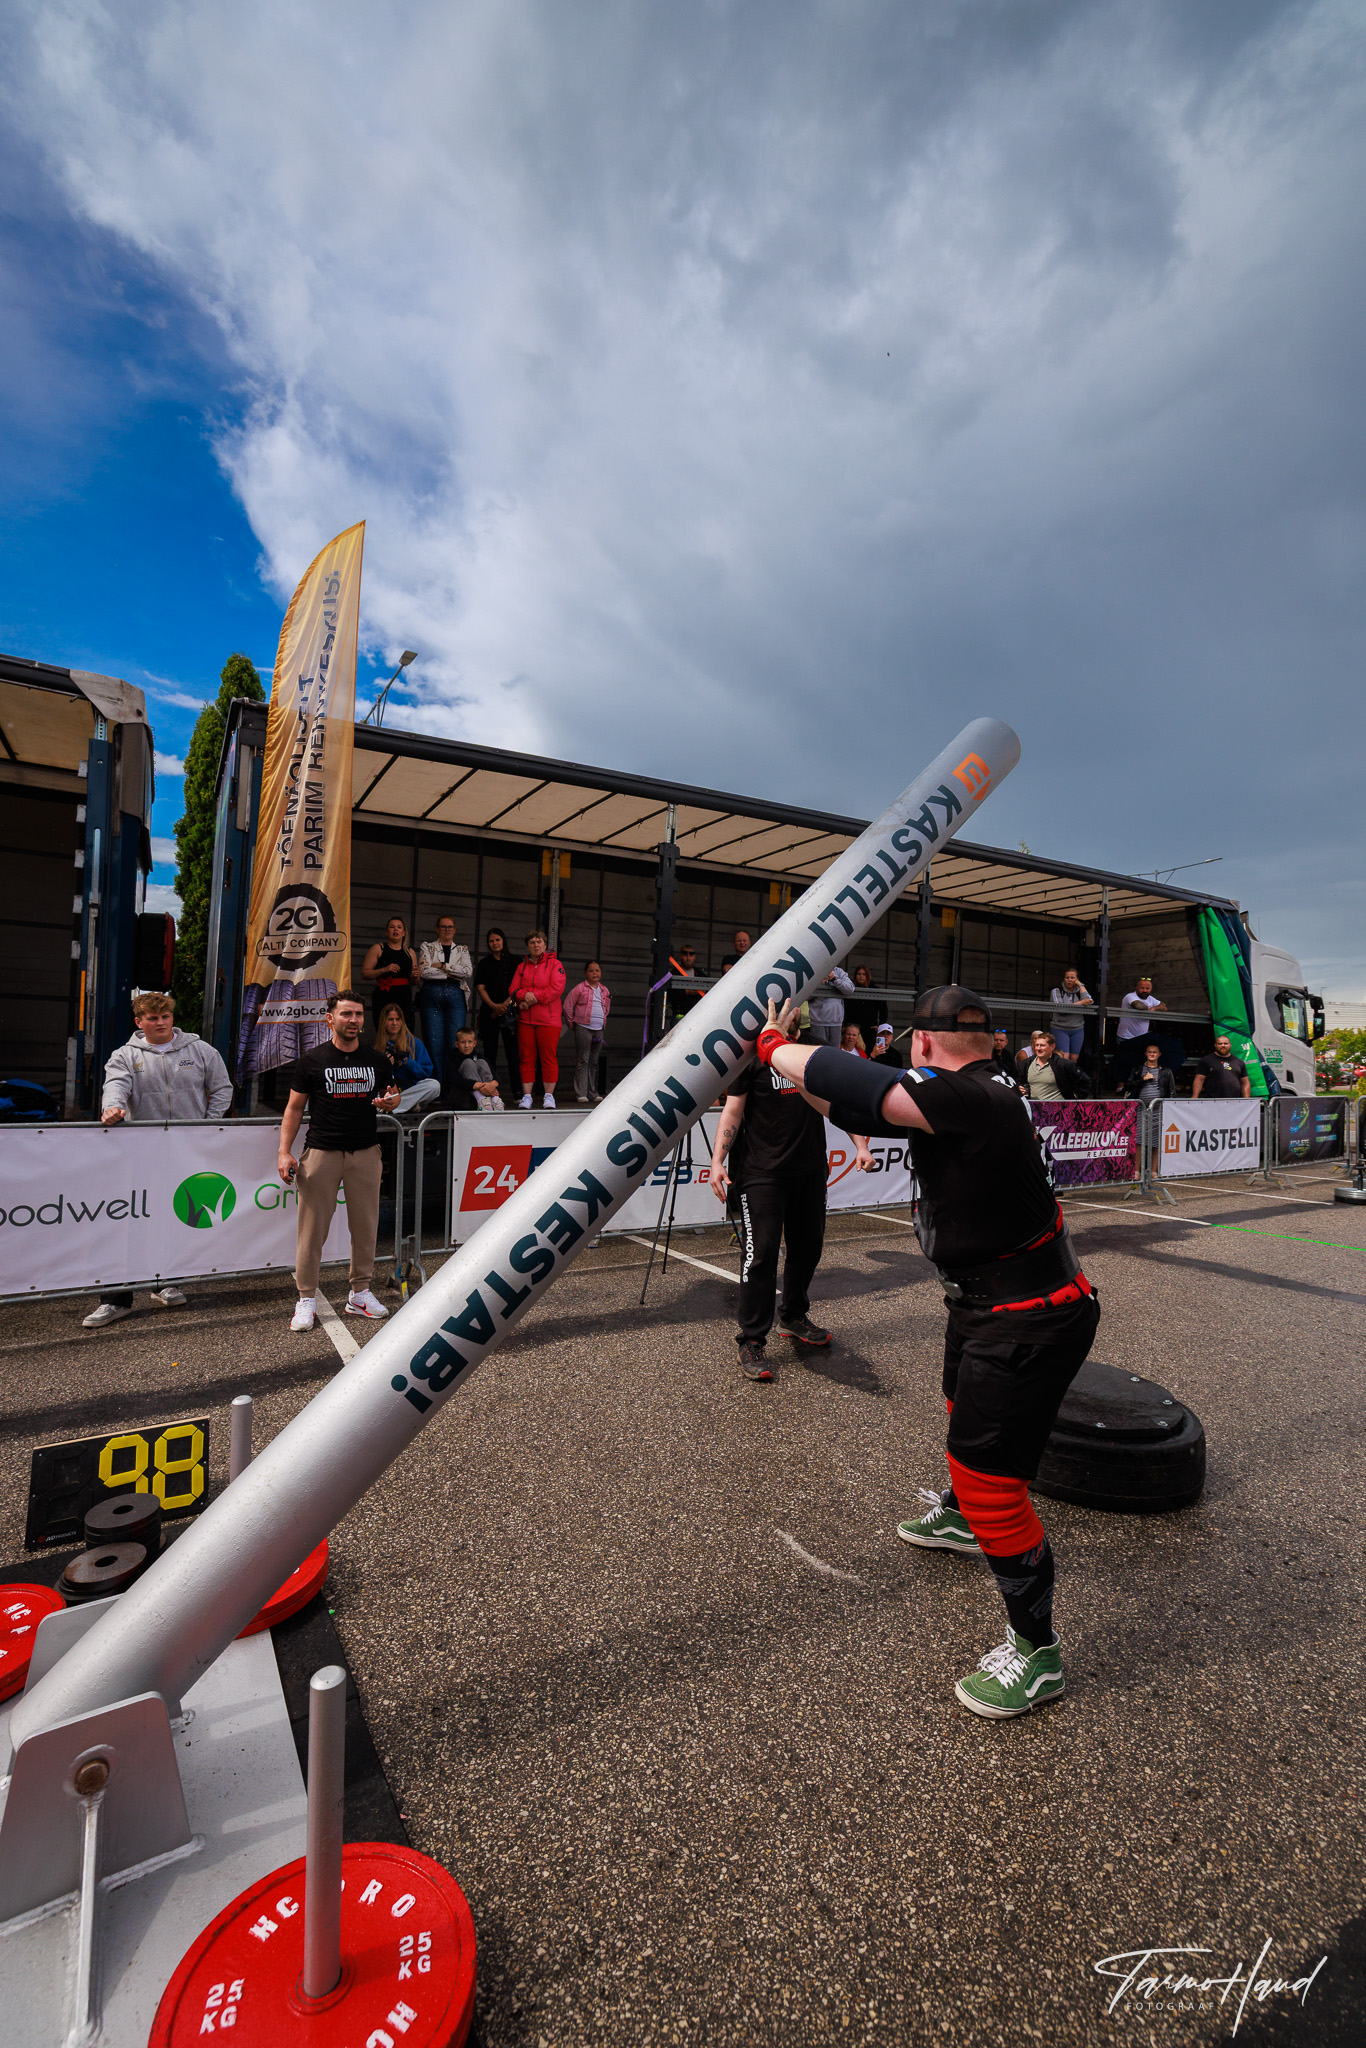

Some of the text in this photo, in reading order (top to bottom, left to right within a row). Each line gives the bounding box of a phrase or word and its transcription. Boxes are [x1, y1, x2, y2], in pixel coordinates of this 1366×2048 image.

[303, 780, 325, 871] PARIM
[808, 784, 963, 956] KASTELLI
[275, 905, 318, 931] 2G
[260, 938, 340, 952] ALTI COMPANY
[260, 1005, 330, 1018] www.2gbc.e
[606, 1076, 698, 1179] MIS
[1050, 1131, 1129, 1150] KLEEBIKUM.EE
[1185, 1126, 1258, 1152] KASTELLI
[474, 1164, 519, 1195] 24
[0, 1189, 150, 1227] odwell
[740, 1193, 755, 1283] RAMMUKOOBAS
[391, 1169, 614, 1414] KESTAB!
[98, 1424, 205, 1510] 98
[399, 1930, 432, 1957] 25
[398, 1954, 431, 1981] KG
[205, 1978, 245, 2009] 25
[199, 2005, 237, 2036] KG
